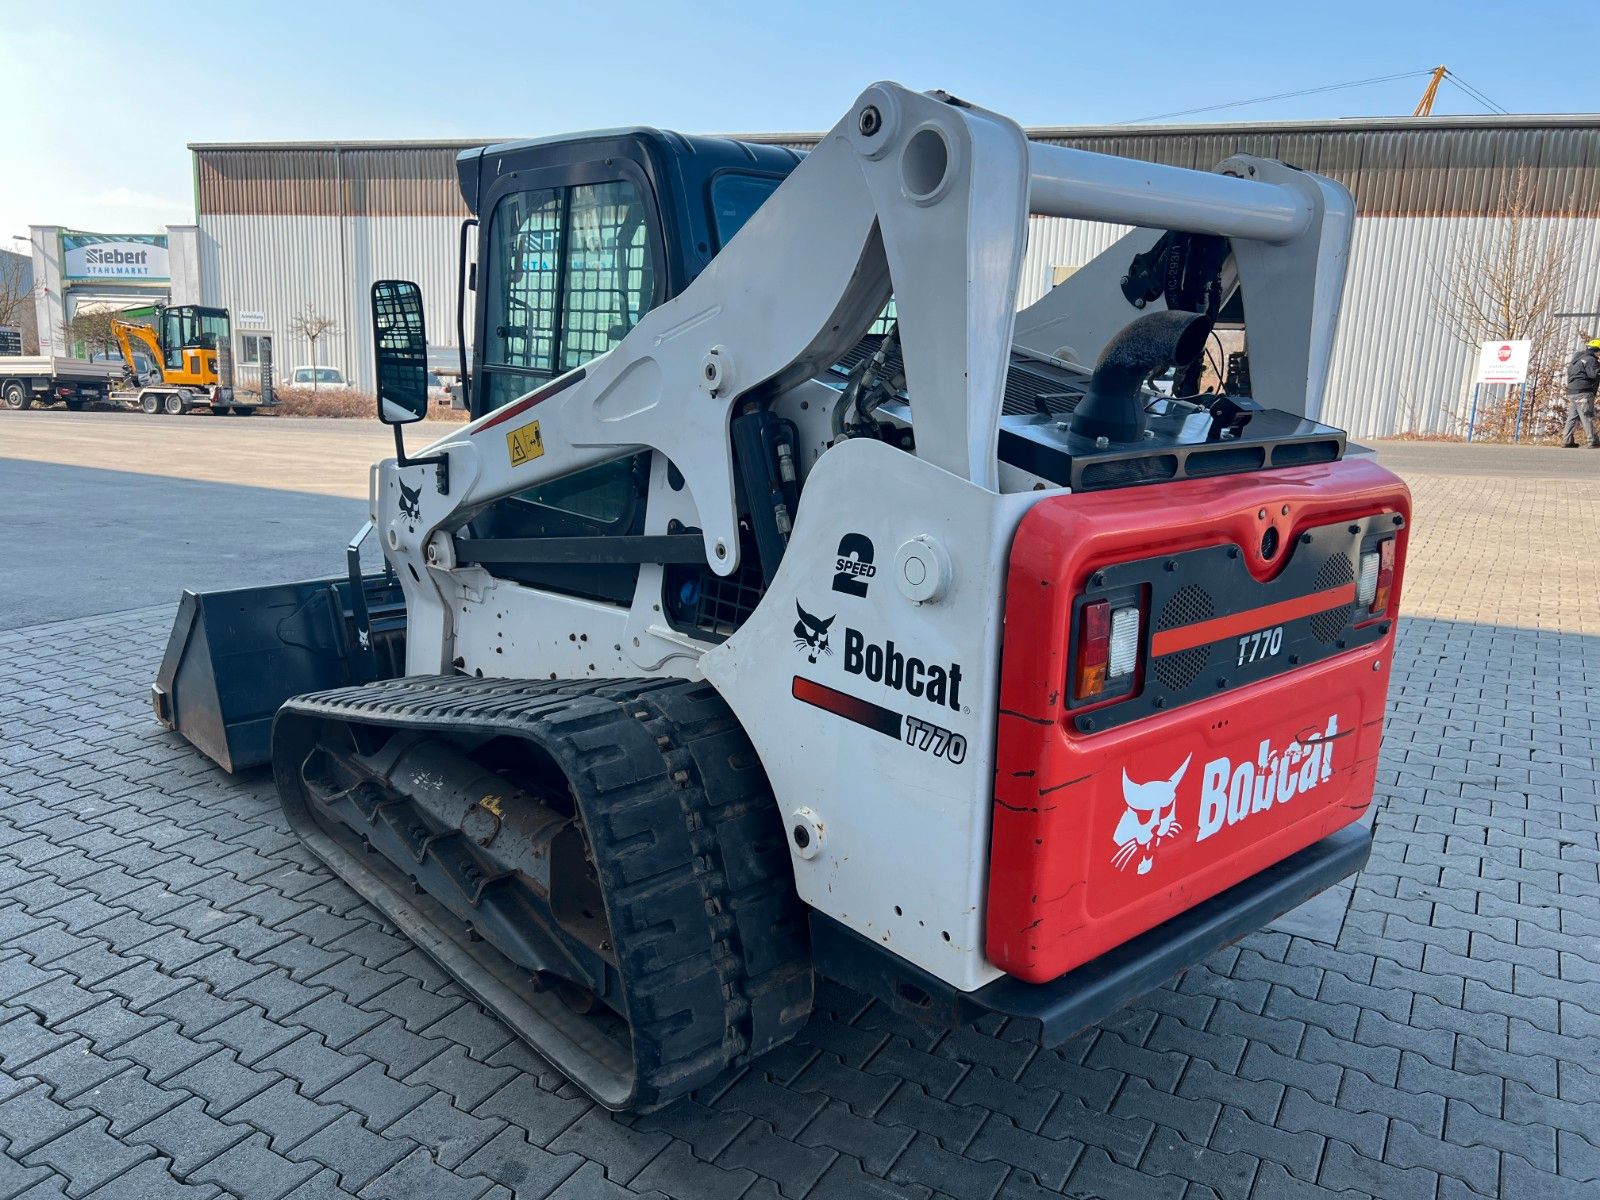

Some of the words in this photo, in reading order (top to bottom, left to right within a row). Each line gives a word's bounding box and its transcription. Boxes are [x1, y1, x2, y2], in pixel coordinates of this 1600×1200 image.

[86, 248, 147, 264] Siebert
[86, 266, 149, 275] STAHLMARKT
[832, 532, 875, 599] 2
[835, 558, 877, 578] SPEED
[1237, 626, 1284, 666] T770
[843, 626, 963, 712] Bobcat
[905, 714, 968, 765] T770
[1196, 713, 1339, 843] Bobcat
